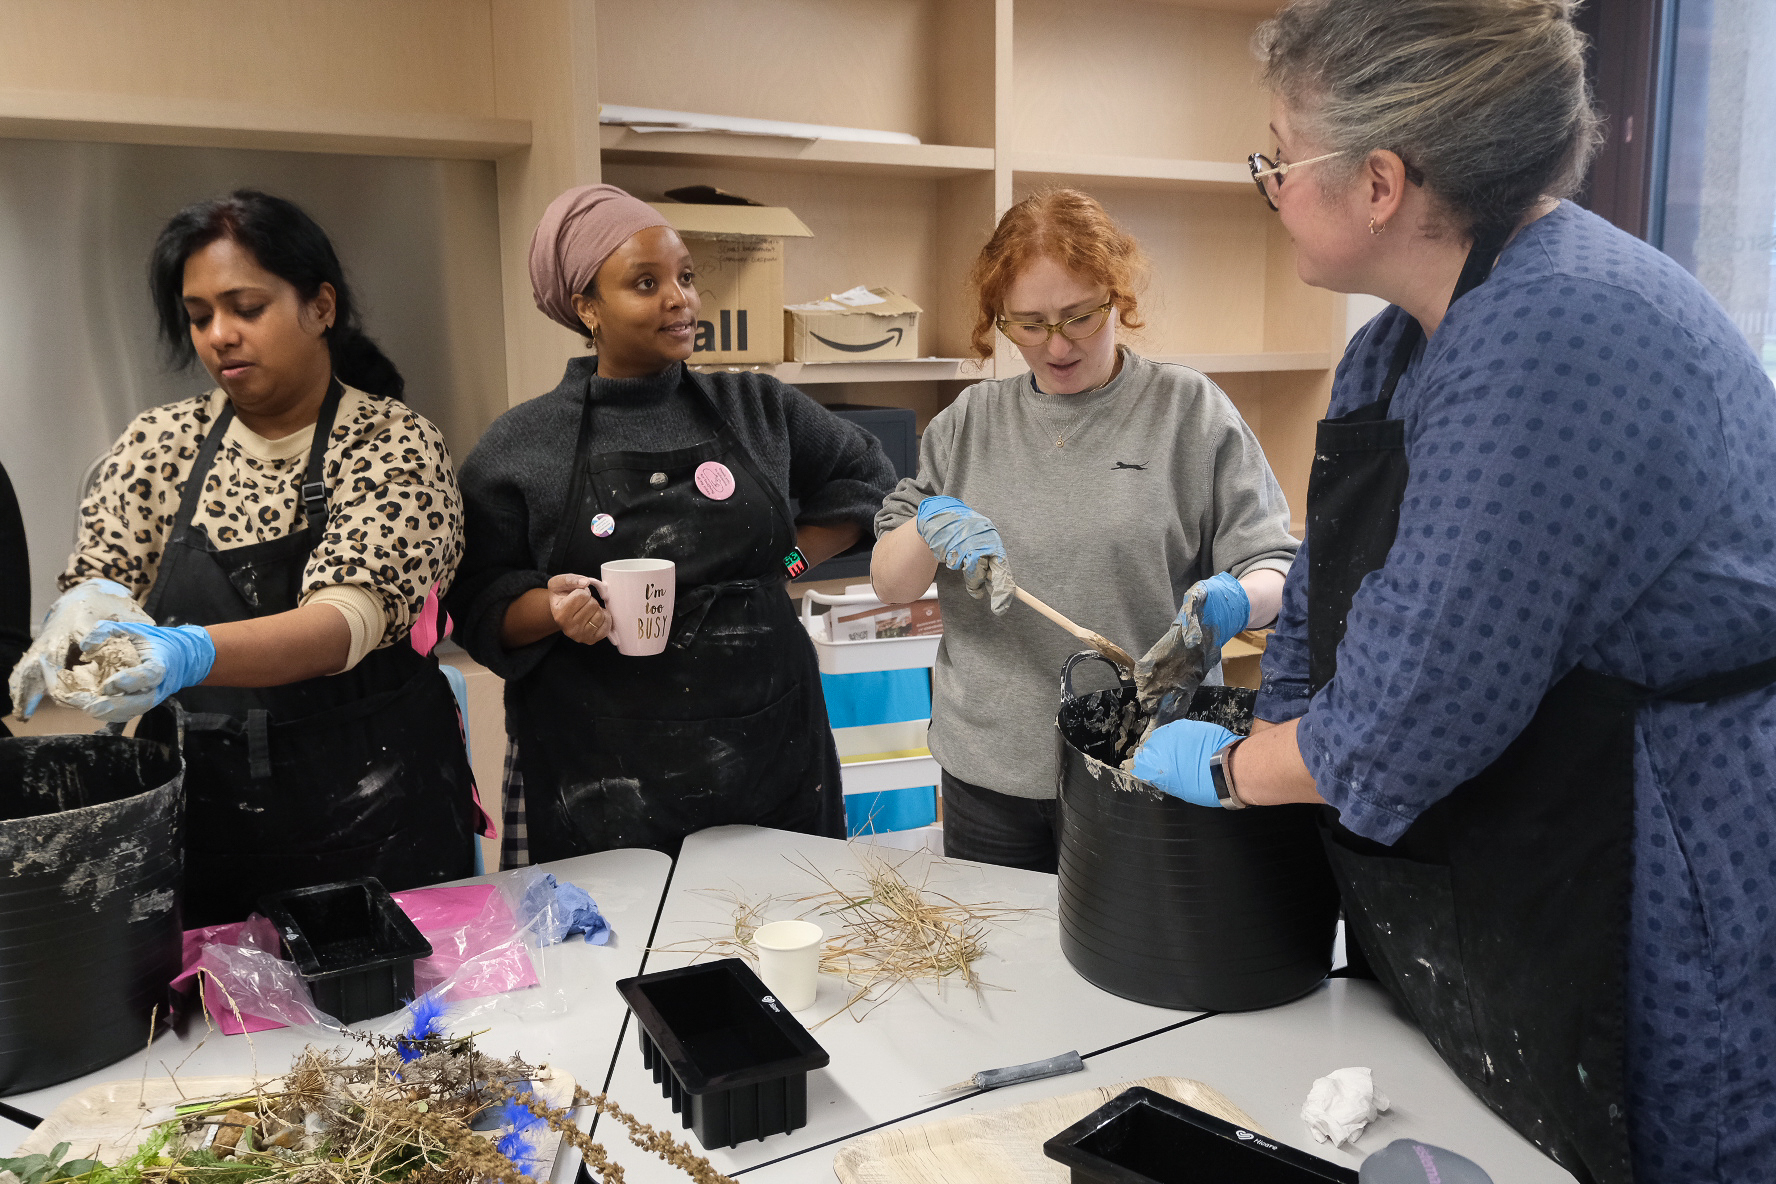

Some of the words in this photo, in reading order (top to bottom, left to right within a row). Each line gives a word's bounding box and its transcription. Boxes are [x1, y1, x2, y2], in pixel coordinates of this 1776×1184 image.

[783, 551, 800, 567] 35
[645, 583, 667, 600] I'm
[645, 602, 665, 615] too
[637, 615, 668, 640] BUSY
